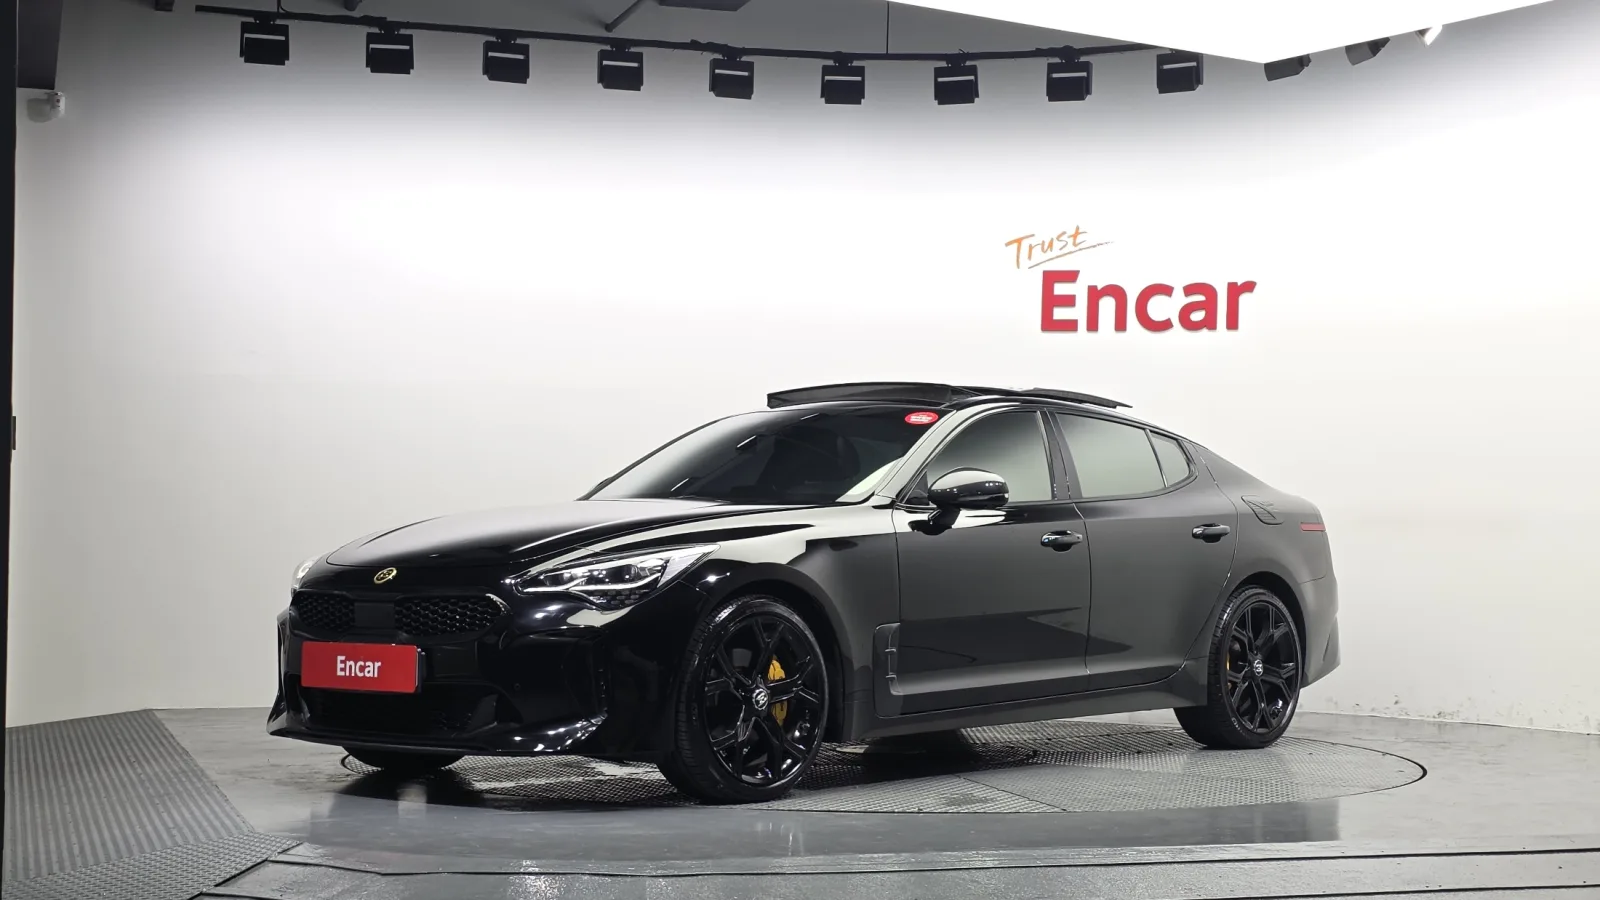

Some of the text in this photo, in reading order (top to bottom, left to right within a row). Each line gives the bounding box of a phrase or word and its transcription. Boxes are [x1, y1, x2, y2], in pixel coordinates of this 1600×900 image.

[1004, 225, 1088, 269] Trust
[1040, 270, 1257, 332] Encar
[336, 655, 382, 678] Encar
